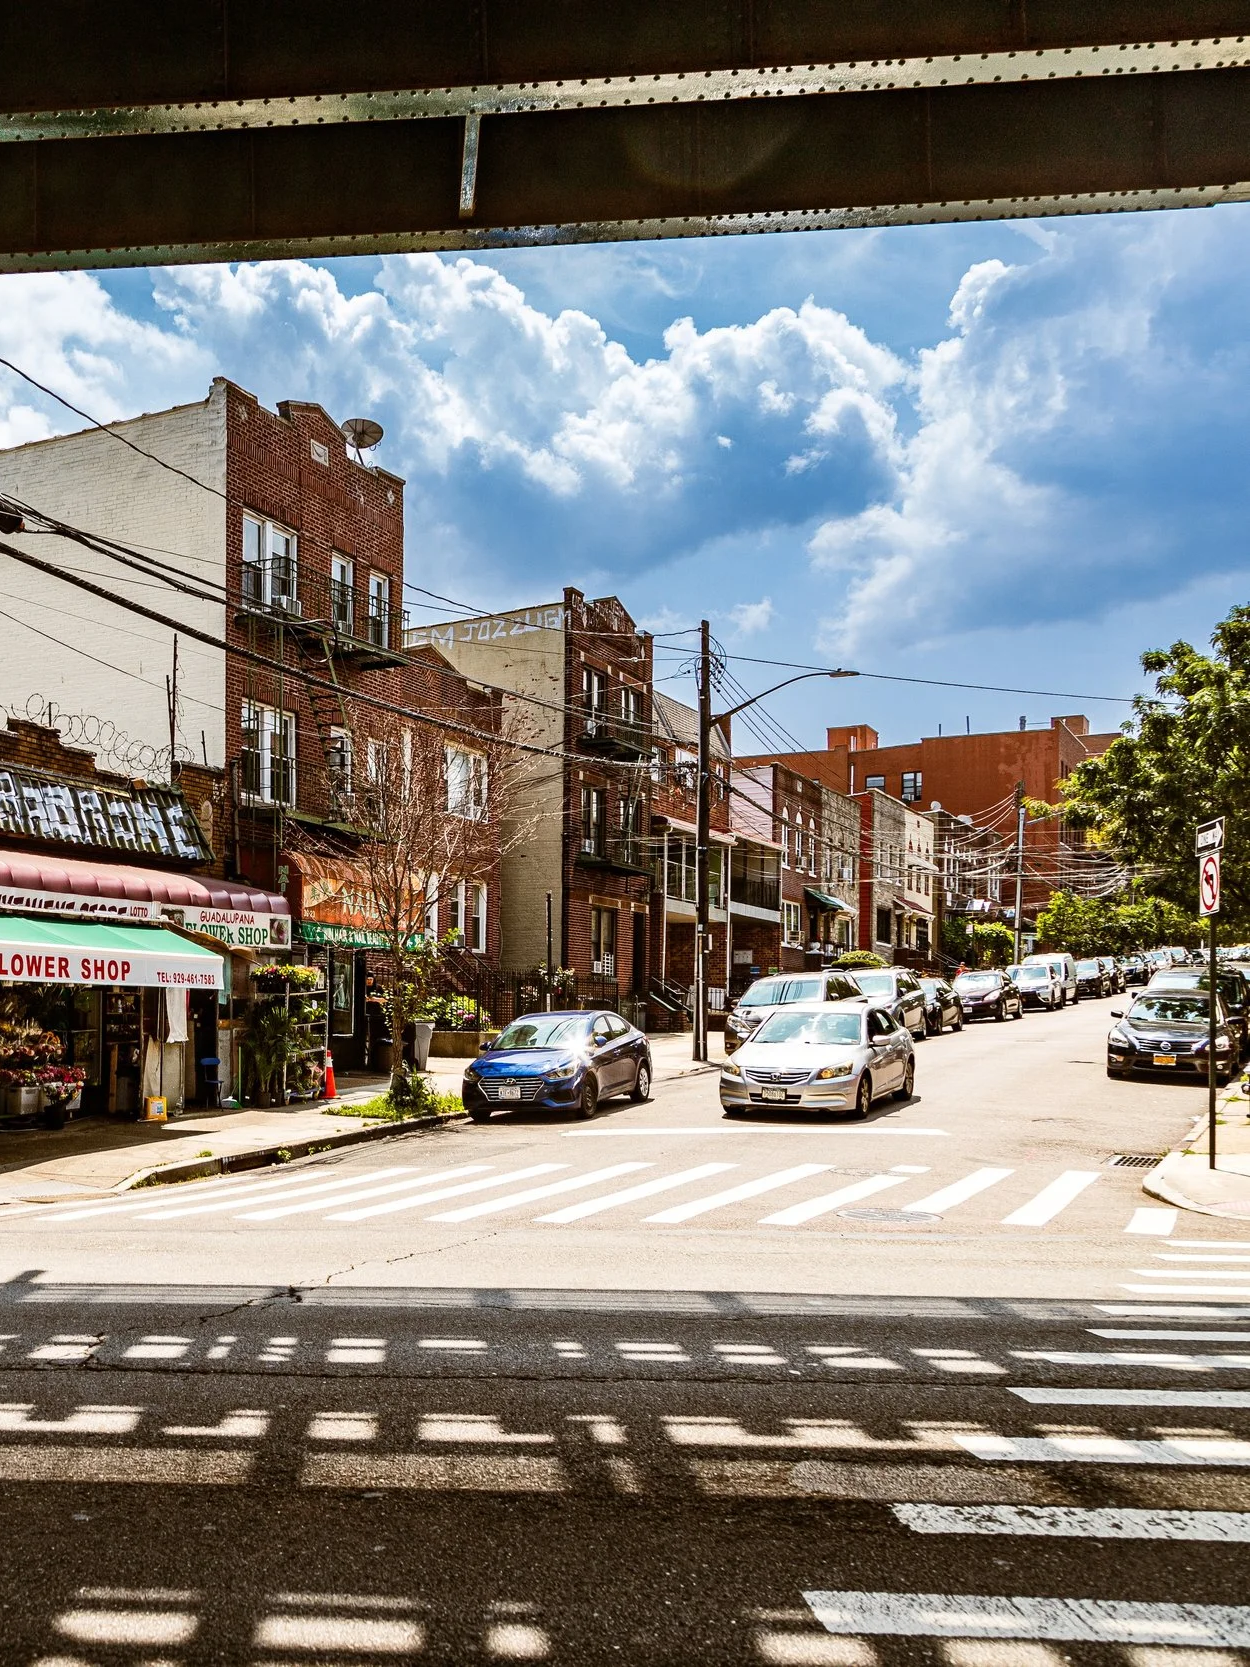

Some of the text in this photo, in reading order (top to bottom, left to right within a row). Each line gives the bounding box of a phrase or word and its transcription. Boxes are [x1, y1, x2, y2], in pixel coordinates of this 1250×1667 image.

[130, 905, 149, 918] LOTTO
[200, 911, 255, 925] GUADALUPANA
[238, 926, 269, 946] SHOP
[81, 958, 131, 982] SHOP
[157, 971, 215, 985] TEL: 929-461-7583
